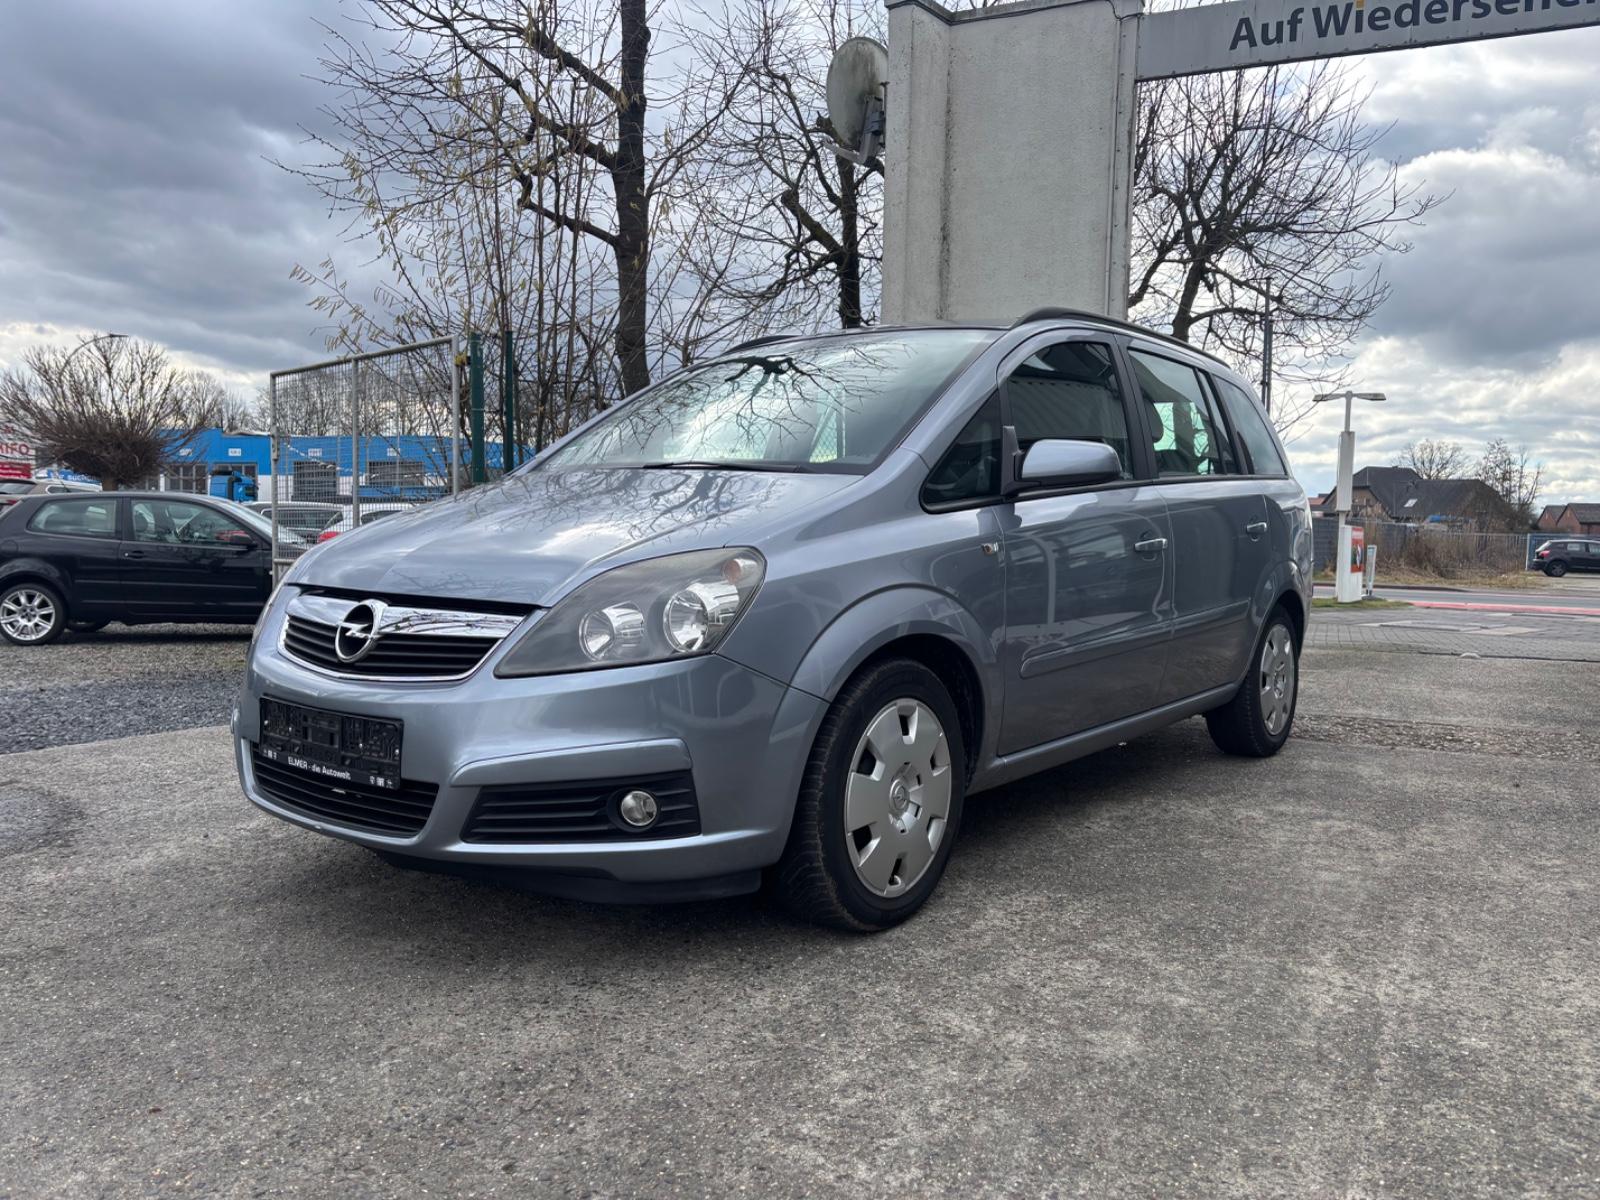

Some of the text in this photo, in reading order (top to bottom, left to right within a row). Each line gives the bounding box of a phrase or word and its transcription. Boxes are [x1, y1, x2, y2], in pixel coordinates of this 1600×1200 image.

[1229, 0, 1600, 50] Auf Wiederse
[288, 756, 308, 770] ELMER
